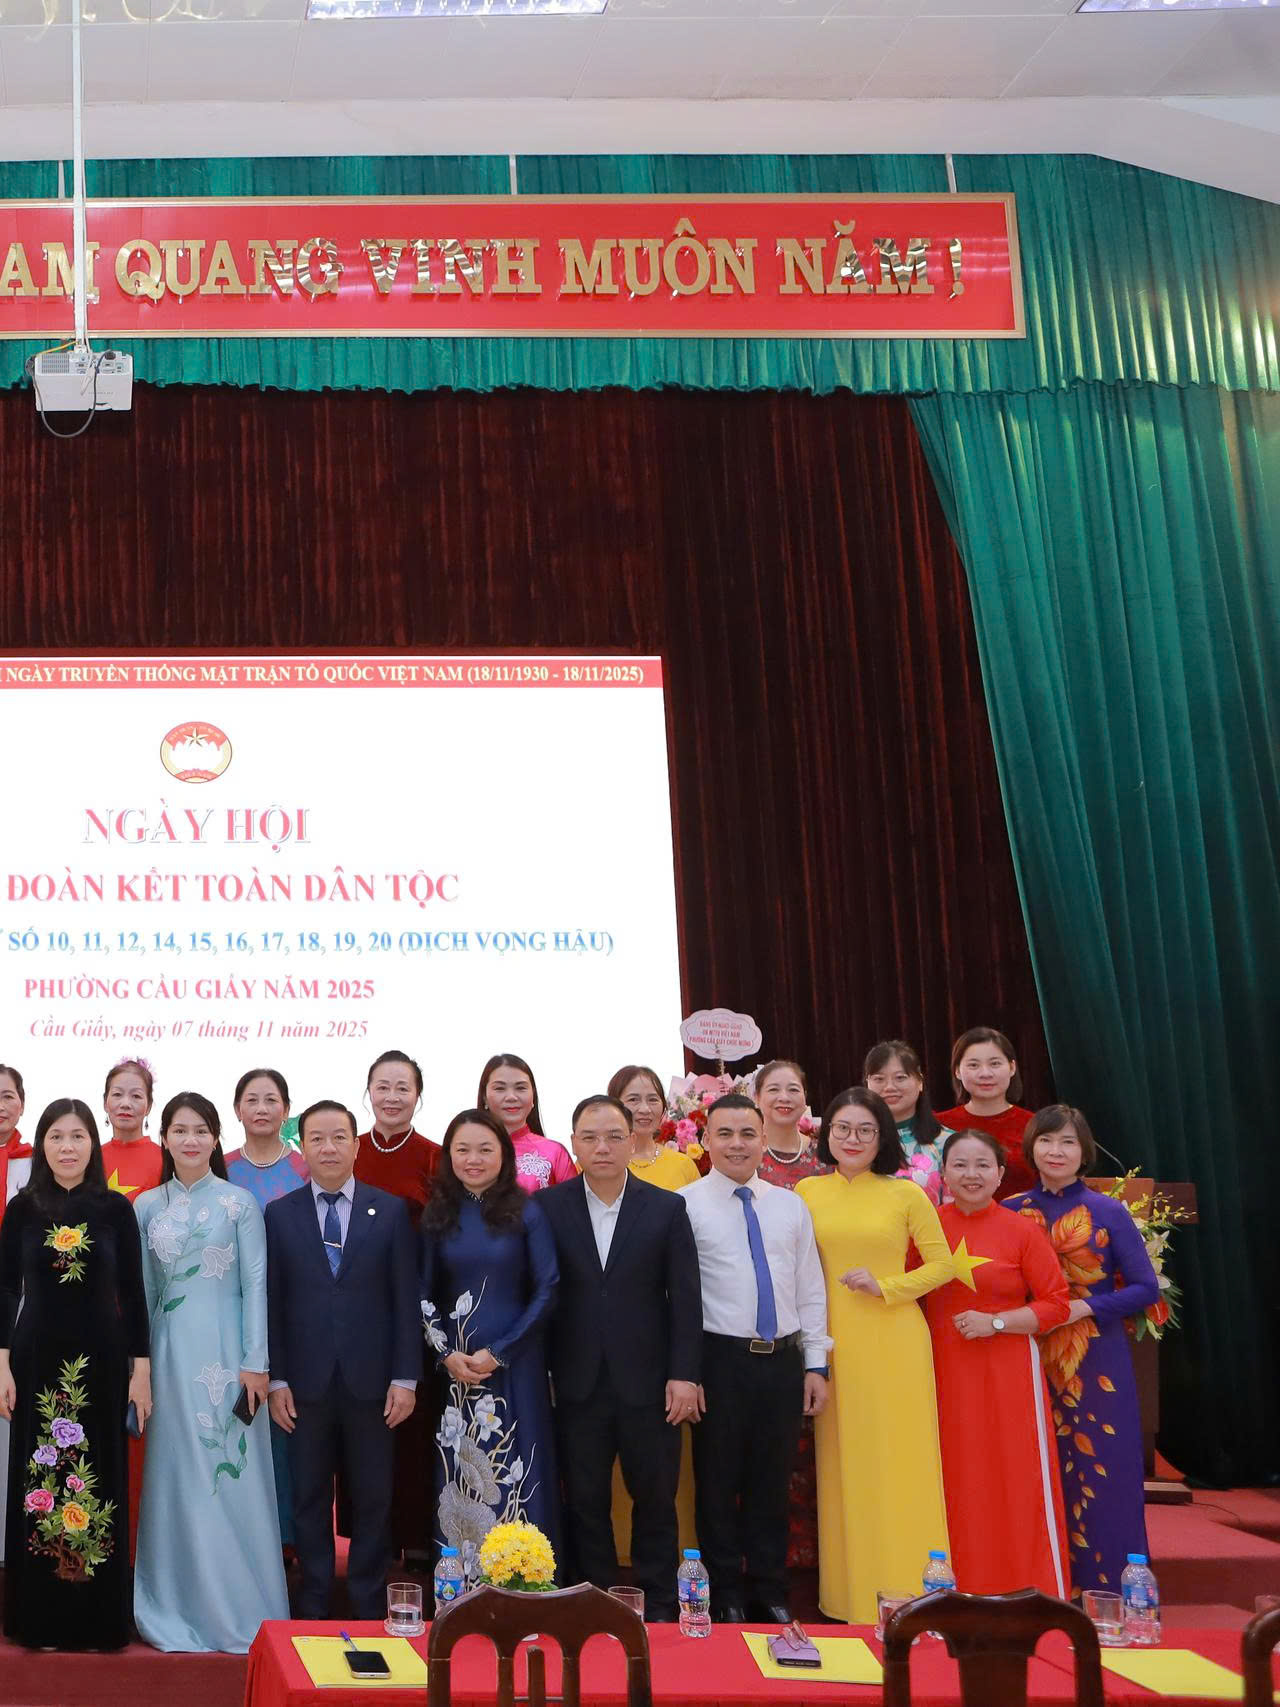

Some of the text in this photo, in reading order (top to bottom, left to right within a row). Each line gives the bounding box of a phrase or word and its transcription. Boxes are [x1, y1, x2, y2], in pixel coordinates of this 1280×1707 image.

[115, 237, 344, 300] QUANG
[361, 239, 542, 295] VINH
[557, 217, 758, 297] MUÔN
[776, 220, 935, 295] NĂM
[6, 664, 56, 682] NGÀY
[59, 664, 129, 682] TRUYỀN
[133, 663, 196, 681] THỐNG
[200, 665, 239, 686] MẶT
[243, 665, 291, 686] TRẬN
[294, 663, 320, 681] TỔ
[323, 663, 374, 683] QUỐC
[377, 666, 419, 686] VIỆT
[423, 666, 463, 681] NAM
[467, 666, 548, 684] (18/11/1930
[562, 666, 644, 684] 18/11/2025)
[82, 798, 312, 853] NGÀY HỘI
[7, 866, 104, 902] ĐOÀN
[117, 867, 187, 902] KẾT
[196, 866, 291, 902] TOÀN
[304, 866, 375, 902] DÂN
[385, 869, 460, 909] TỘC
[8, 926, 40, 951] SỐ
[46, 932, 76, 955] 10,
[82, 932, 110, 955] 11,
[117, 932, 146, 955] 12,
[153, 932, 182, 955] 14,
[188, 932, 218, 955] 15,
[224, 932, 254, 955] 16,
[261, 932, 290, 955] 17,
[297, 932, 326, 955] 18,
[333, 932, 362, 955] 19,
[369, 932, 392, 952] 20
[399, 931, 467, 956] (DỊCH
[476, 931, 546, 957] VỌNG
[554, 928, 614, 957] HẬU)
[25, 973, 375, 1000] PHƯỜNG CẦU GIẤY NĂM 2025
[30, 1014, 370, 1042] Cầu Giấy, ngày 07 tháng 11 năm 2025
